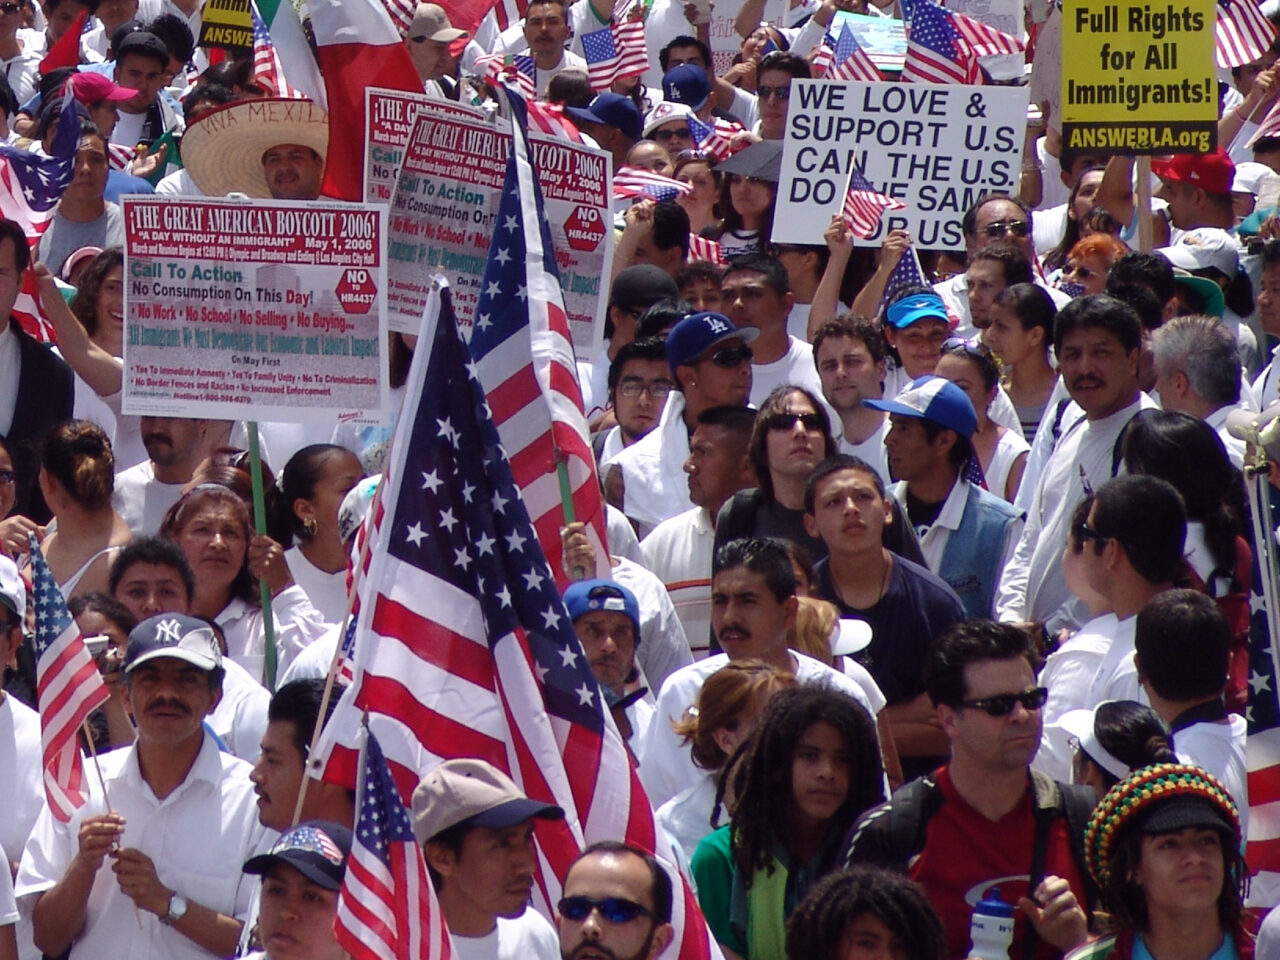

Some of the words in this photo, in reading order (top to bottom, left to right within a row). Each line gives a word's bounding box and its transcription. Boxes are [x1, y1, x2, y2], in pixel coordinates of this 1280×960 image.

[1075, 6, 1119, 34] Full
[1127, 6, 1205, 38] Rights
[1100, 42, 1135, 70] for
[1144, 42, 1178, 71] All
[798, 83, 847, 111] WE
[863, 86, 950, 117] LOVE
[965, 92, 987, 118] &
[1068, 76, 1212, 111] Immigrants!
[790, 114, 948, 148] SUPPORT
[964, 124, 1020, 154] U.S.
[1070, 126, 1211, 154] ANSWERLA.org
[796, 146, 868, 176] CAN
[888, 152, 952, 182] THE
[960, 160, 1015, 187] U.S.
[789, 177, 836, 205] DO
[163, 208, 204, 232] GREAT
[206, 209, 273, 237] AMERICAN
[276, 211, 337, 238] BOYCOTT
[340, 212, 377, 239] 2006!
[172, 233, 216, 244] WITHOUT
[305, 238, 328, 252] May
[344, 239, 372, 251] 2006
[131, 262, 162, 279] Call
[167, 263, 187, 279] To
[192, 265, 243, 283] Action
[347, 270, 368, 284] NO
[132, 281, 149, 296] No
[153, 282, 232, 302] Consumption
[234, 287, 252, 301] On
[256, 288, 282, 303] This
[286, 289, 314, 308] Day!
[341, 293, 375, 304] HR4437
[703, 316, 728, 334] LA
